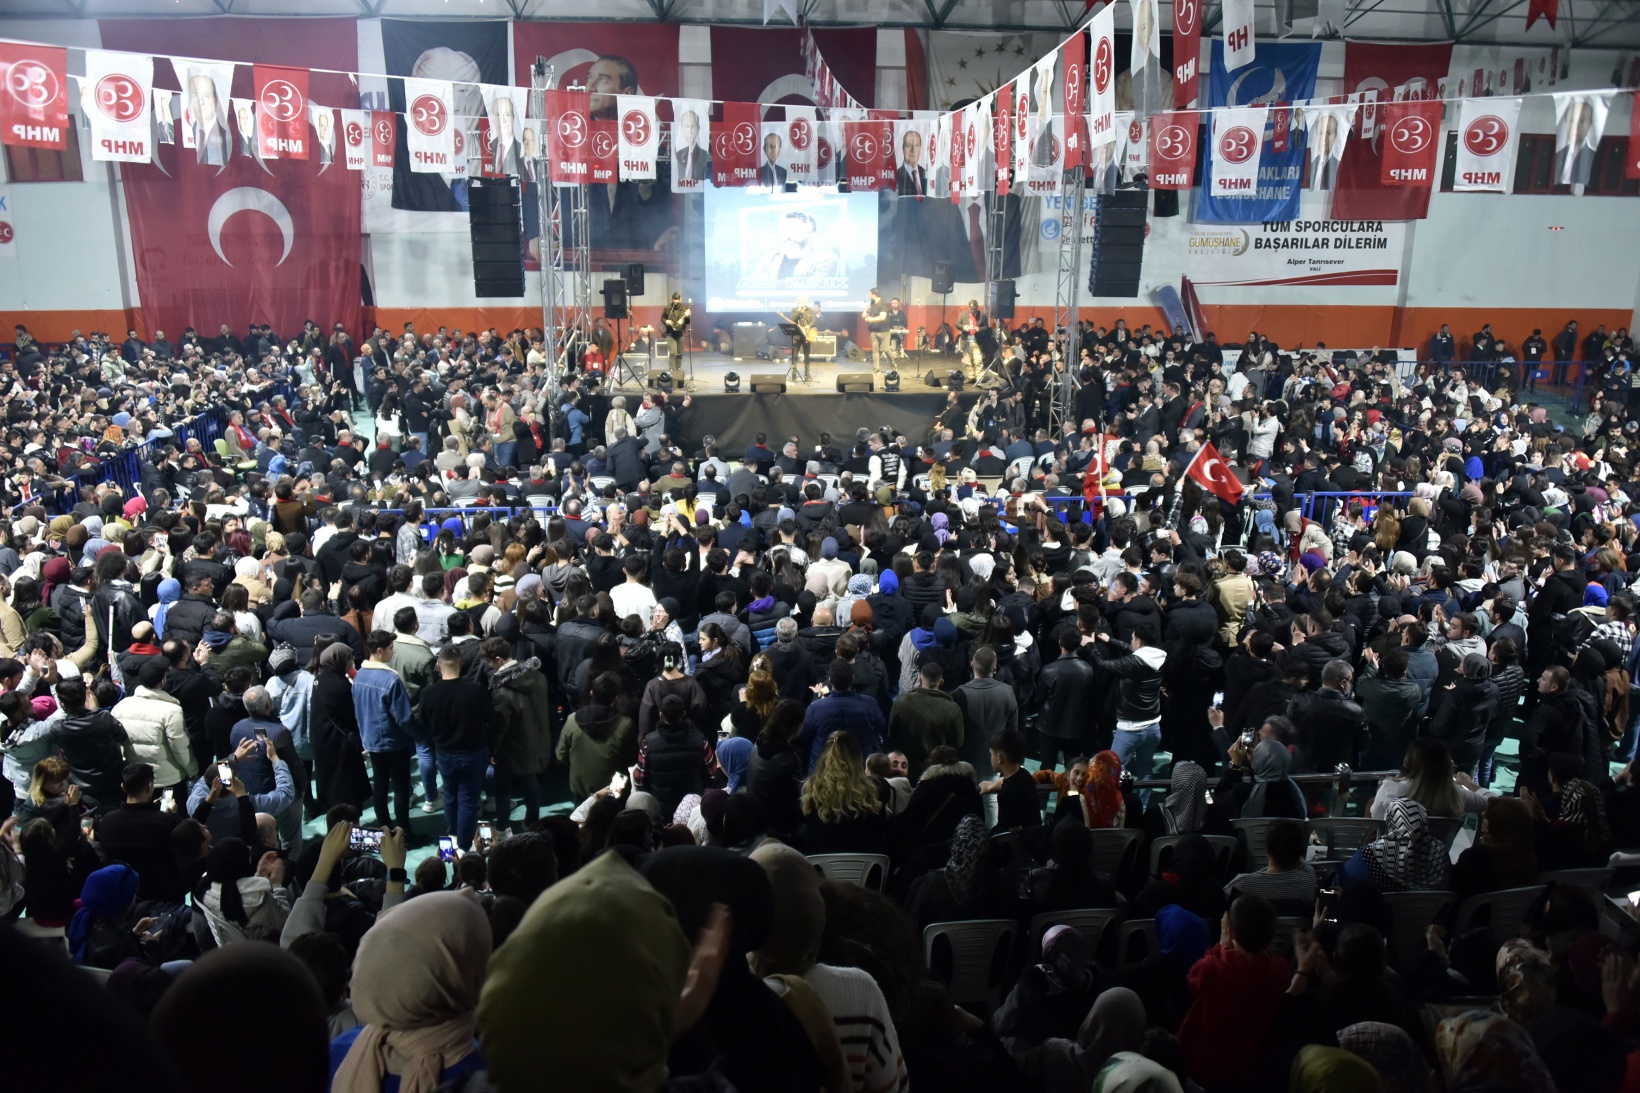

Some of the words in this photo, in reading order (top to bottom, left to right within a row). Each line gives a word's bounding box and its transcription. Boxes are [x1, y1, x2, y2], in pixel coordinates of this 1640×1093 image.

[594, 170, 612, 179] MHP
[678, 179, 699, 187] MHP
[852, 176, 876, 186] MHP
[1295, 220, 1383, 233] SPORCULARA
[1254, 237, 1328, 253] BAŞARILAR
[1334, 234, 1388, 249] DİLERİM
